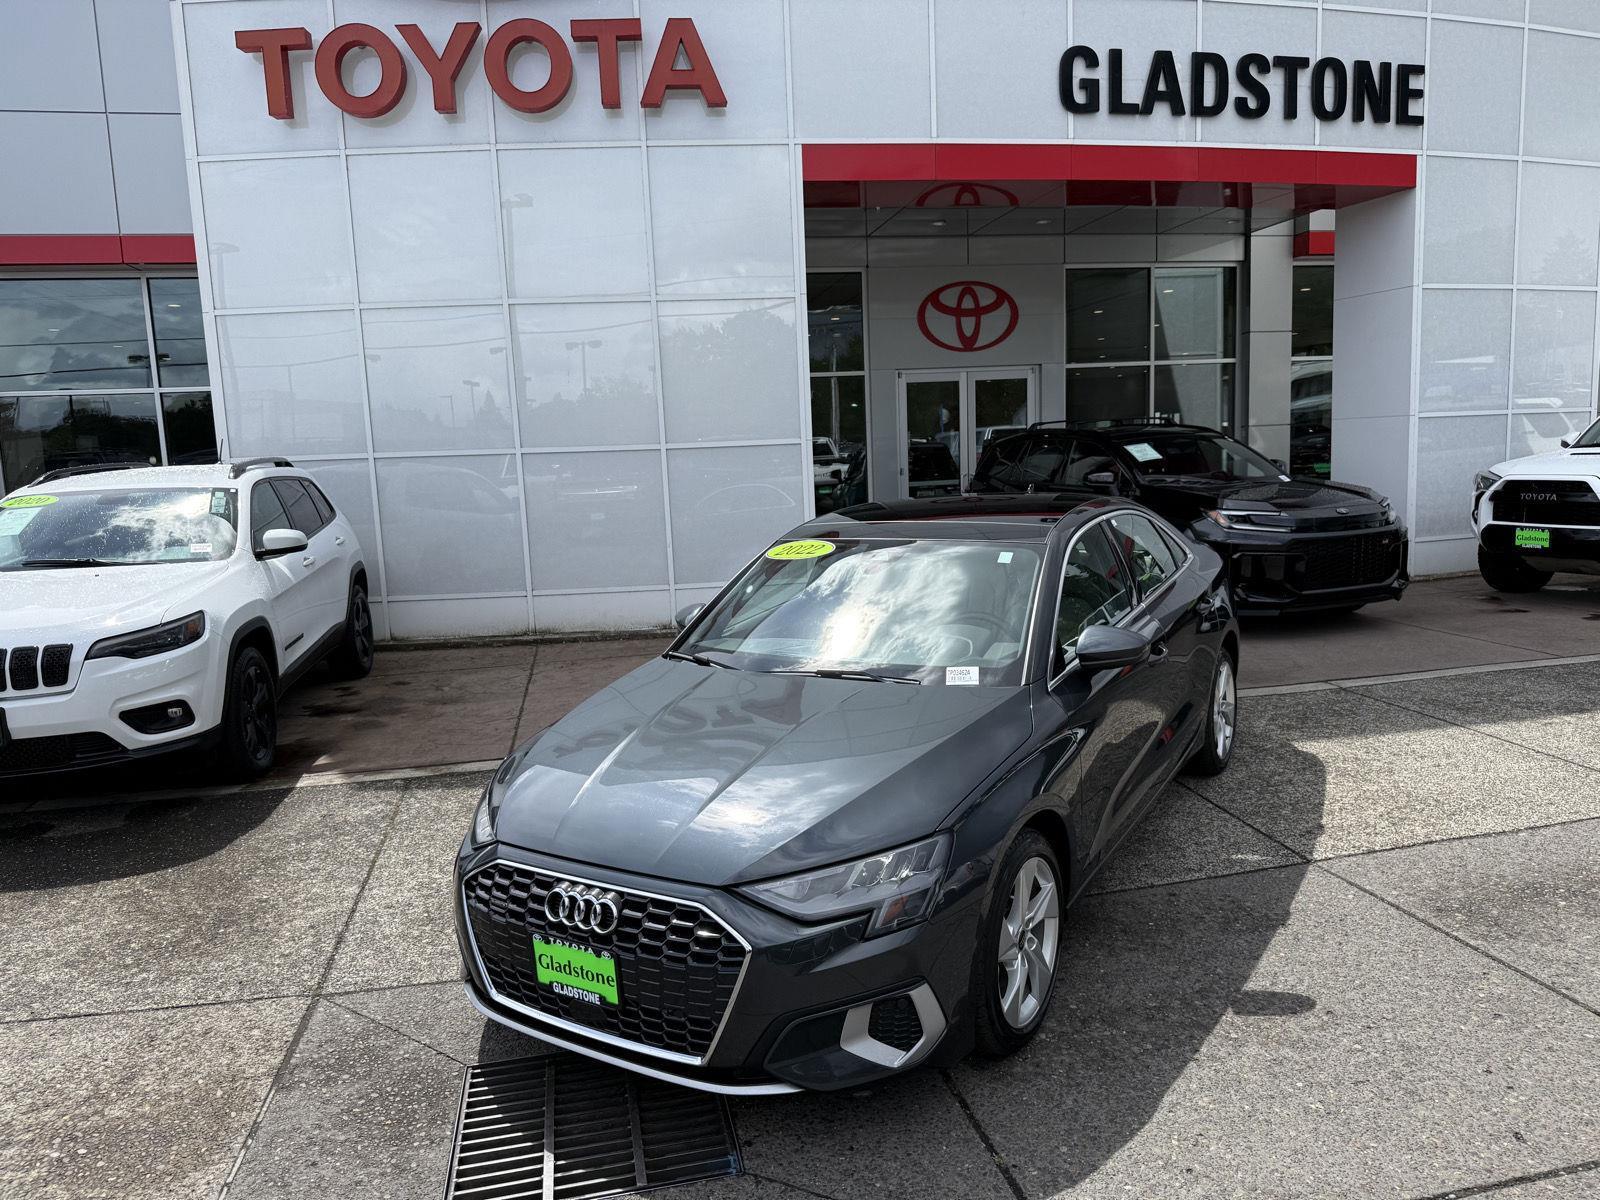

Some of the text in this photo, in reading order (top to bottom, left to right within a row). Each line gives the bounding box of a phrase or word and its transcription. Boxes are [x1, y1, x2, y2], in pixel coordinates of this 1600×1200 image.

[235, 17, 727, 119] TOYOTA
[1059, 45, 1425, 126] GLADSTONE
[7, 497, 51, 506] 2020
[1519, 493, 1558, 502] TOYOTA
[1516, 534, 1549, 543] Gladstone
[773, 544, 826, 556] 2022
[548, 937, 596, 956] TOYOTA
[537, 953, 616, 988] Gladstone
[552, 982, 602, 1006] GLADSTONE
